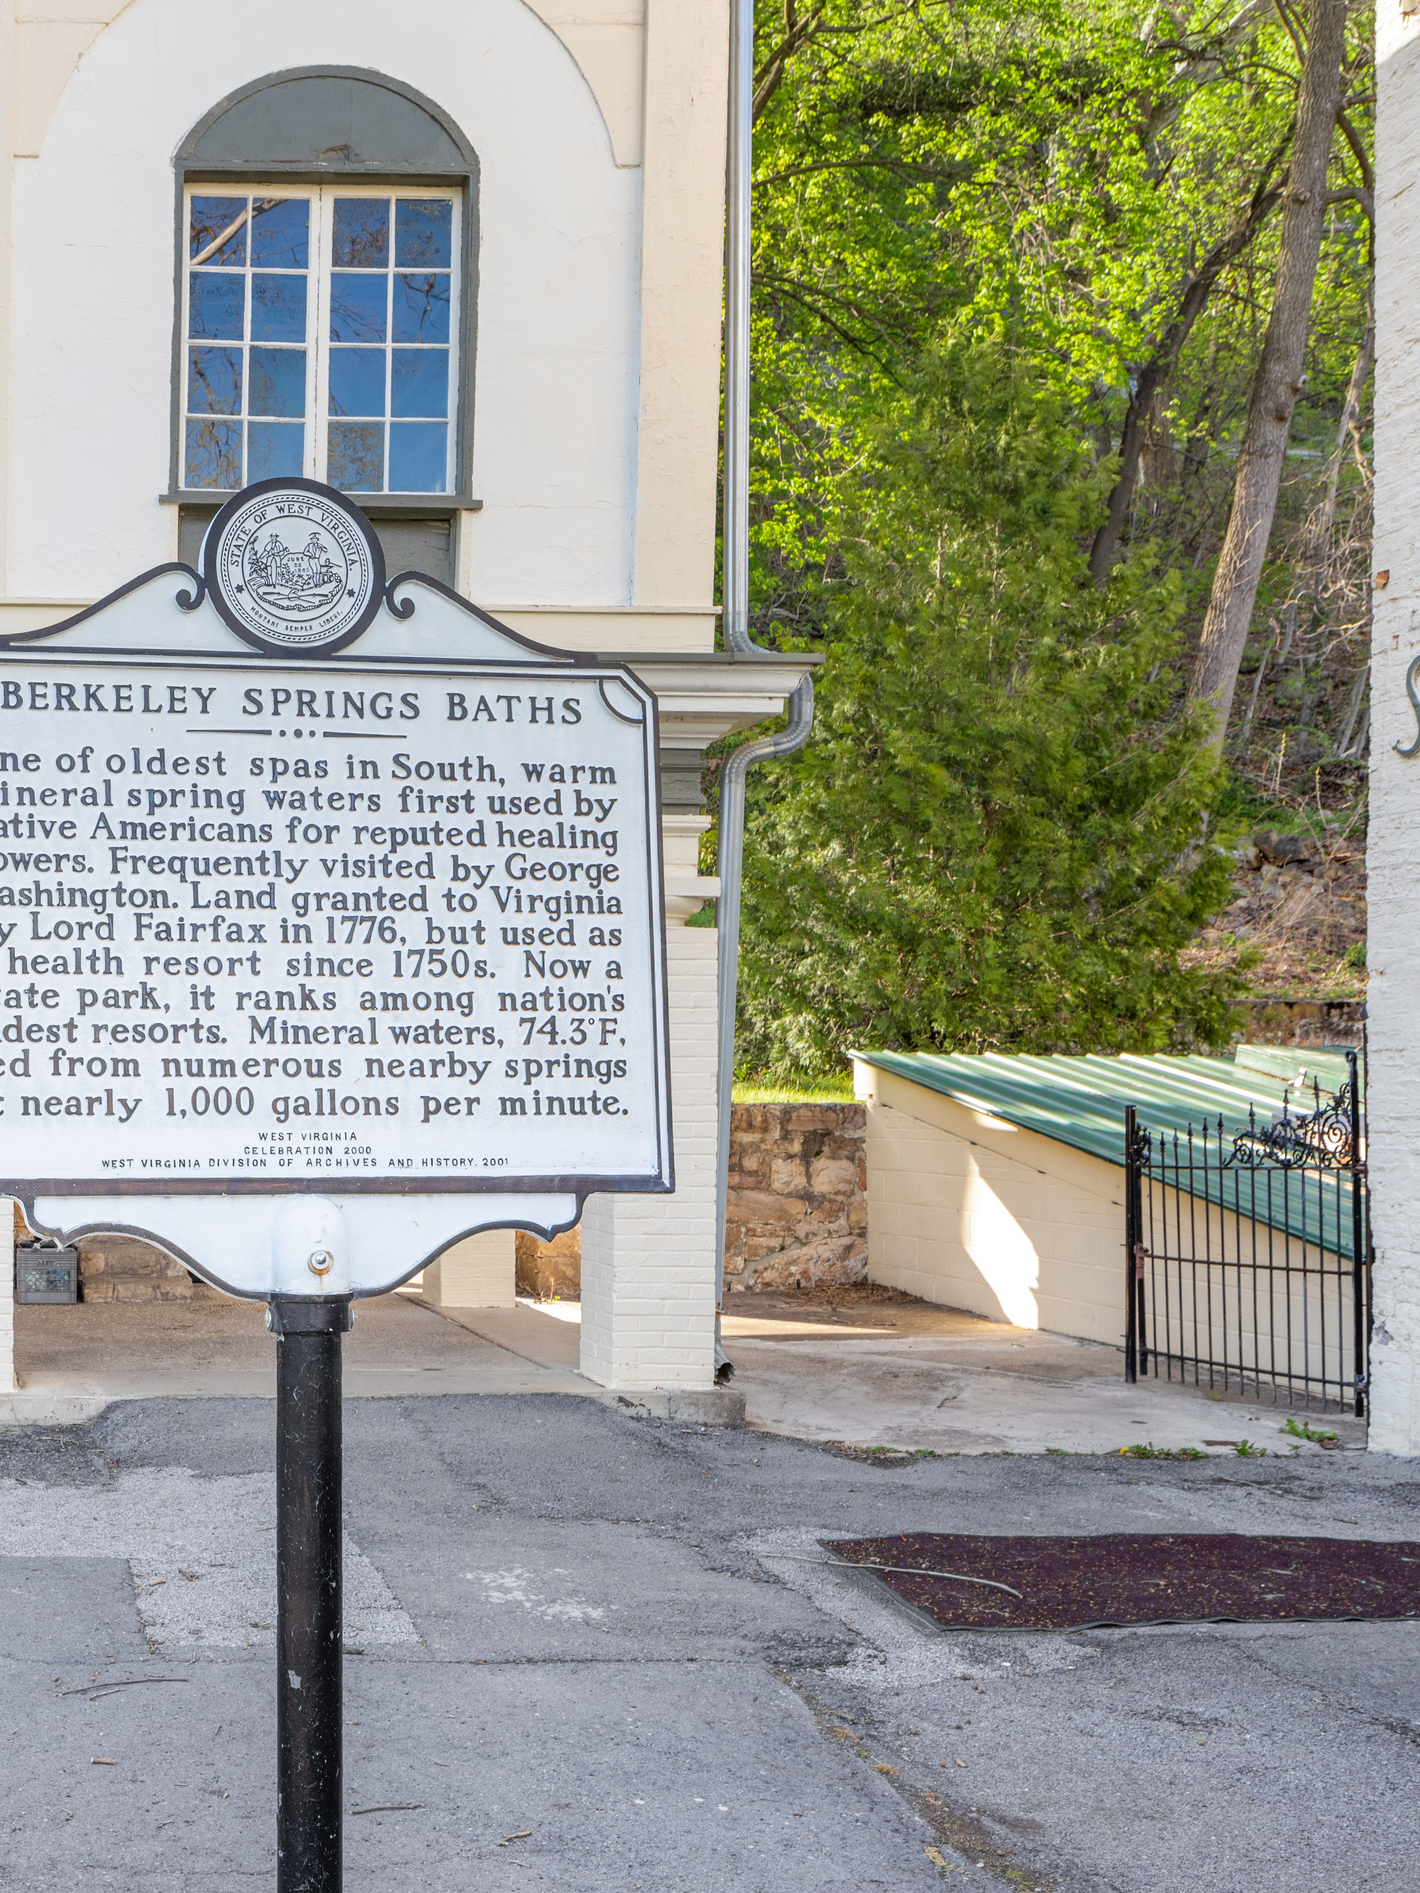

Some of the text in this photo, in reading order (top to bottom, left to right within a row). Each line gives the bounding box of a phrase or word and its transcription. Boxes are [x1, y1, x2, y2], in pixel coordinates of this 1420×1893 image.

[230, 525, 252, 567] STATE
[253, 509, 268, 524] OF
[275, 503, 313, 517] WEST
[249, 605, 279, 629] MONTANI
[284, 624, 314, 632] SEMPER
[1, 681, 581, 724] BERKELEY SPRINGS BATHS
[56, 746, 94, 773] of
[106, 748, 226, 776] oldest
[250, 758, 328, 783] spas
[347, 754, 380, 779] in
[392, 753, 505, 787] South,
[521, 762, 617, 784] warm
[128, 783, 245, 816] spring
[262, 786, 380, 812] waters
[399, 786, 475, 814] first
[487, 789, 563, 815] used
[574, 789, 618, 823] by
[90, 812, 272, 842] Americans
[285, 816, 340, 844] for
[353, 820, 487, 853] reputed
[496, 821, 618, 857] healing
[109, 846, 309, 884] Frequently
[319, 852, 435, 879] visited
[451, 855, 495, 890] by
[505, 853, 619, 889] George
[190, 881, 277, 909] Land
[292, 885, 429, 918] granted
[442, 888, 477, 912] to
[490, 886, 623, 922] Virginia
[30, 911, 115, 941] Lord
[134, 912, 267, 943] Fairfax
[280, 918, 312, 943] in
[327, 915, 406, 946] 1776,
[425, 917, 486, 945] but
[500, 919, 576, 946] used
[589, 927, 621, 946] as
[8, 947, 124, 975] health
[143, 951, 261, 976] resort
[287, 952, 373, 977] since
[394, 948, 495, 978] 1750s.
[523, 950, 591, 978] Now
[606, 961, 623, 979] a
[77, 982, 170, 1015] park,
[190, 984, 215, 1011] it
[236, 984, 336, 1010] ranks
[360, 991, 474, 1017] among
[498, 985, 625, 1012] nation's
[92, 1018, 227, 1044] resorts.
[248, 1016, 378, 1044] Mineral
[388, 1019, 503, 1048] waters,
[49, 1048, 141, 1077] from
[161, 1058, 341, 1078] numerous
[365, 1051, 492, 1085] nearby
[505, 1053, 626, 1085] springs
[21, 1089, 142, 1123] nearly
[166, 1086, 254, 1119] 1,000
[272, 1088, 399, 1123] gallons
[420, 1096, 480, 1123] per
[498, 1090, 628, 1115] minute.
[243, 1145, 372, 1156] CELEBRATION 2000
[257, 1131, 358, 1142] WEST VIRGINIA
[101, 1158, 134, 1169] WEST
[140, 1158, 201, 1169] VIRGINIA
[208, 1157, 267, 1168] DIVISION
[278, 1158, 294, 1167] OF
[305, 1157, 377, 1167] ARCHIVES
[388, 1158, 414, 1169] AND
[482, 1157, 509, 1167] 2001
